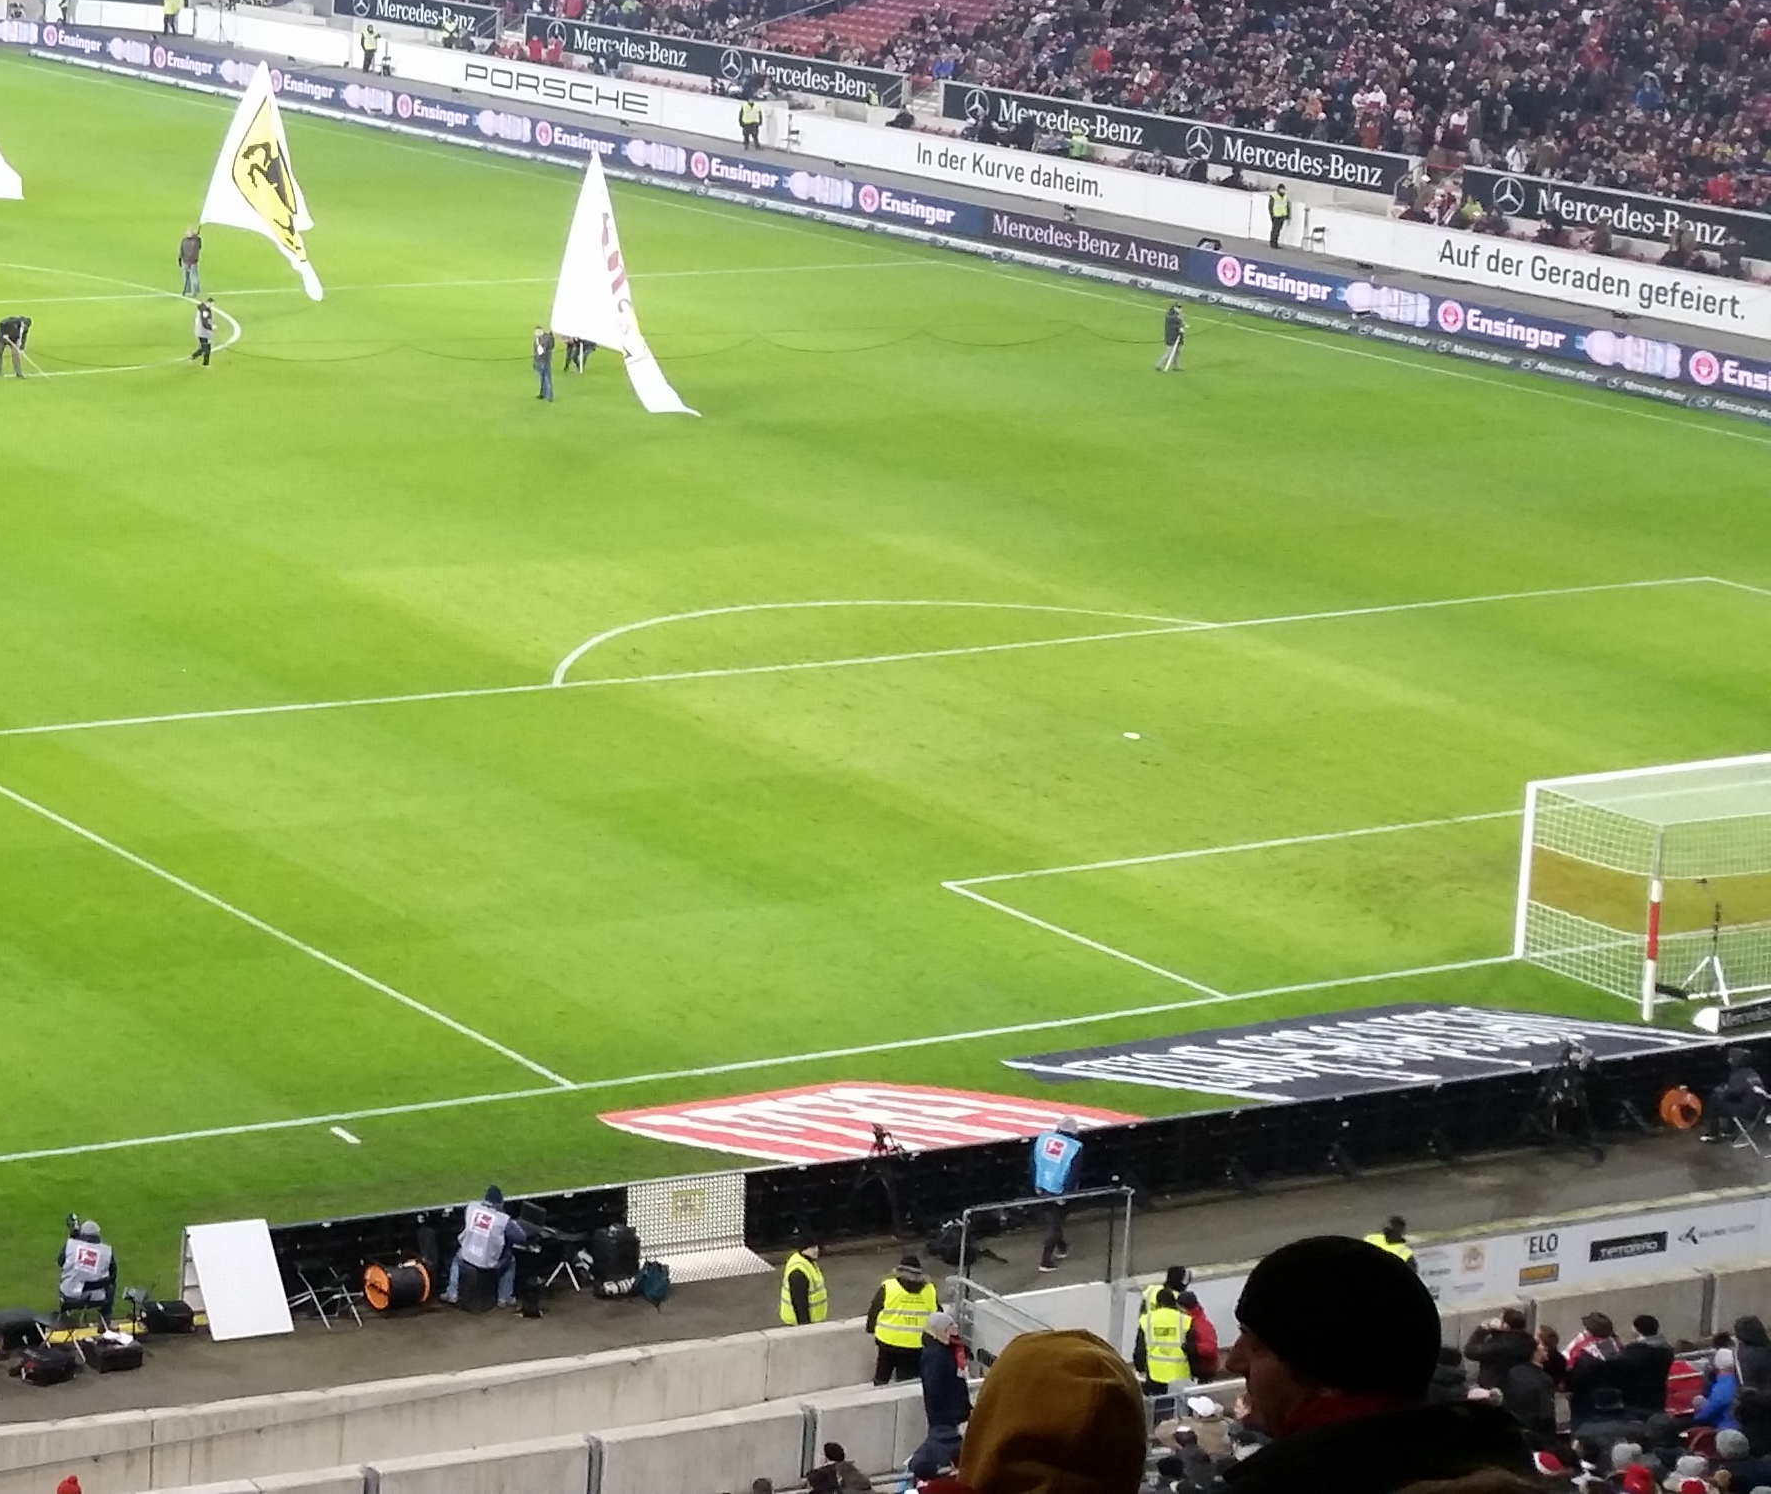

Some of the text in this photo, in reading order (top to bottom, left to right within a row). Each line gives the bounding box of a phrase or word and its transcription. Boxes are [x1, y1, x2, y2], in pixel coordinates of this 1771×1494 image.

[58, 30, 102, 53] Ensinger
[167, 54, 214, 75] Ensinger
[283, 74, 336, 100] Ensinger
[465, 63, 649, 115] PORSCHE
[413, 104, 470, 128] Ensinger
[553, 126, 616, 155] Ensinger
[710, 157, 780, 189] Ensinger
[916, 142, 1105, 199] In der Kurve daheim.
[1222, 135, 1384, 188] Mercedes-Benz
[880, 191, 957, 227] Ensinger
[991, 213, 1180, 272] Mercedes-Benz Arena
[1243, 263, 1333, 302] Ensinger
[1438, 238, 1747, 321] Auf der Geraden gefeiert.
[1466, 309, 1566, 351] Ensinger
[1529, 1233, 1559, 1255] ELO
